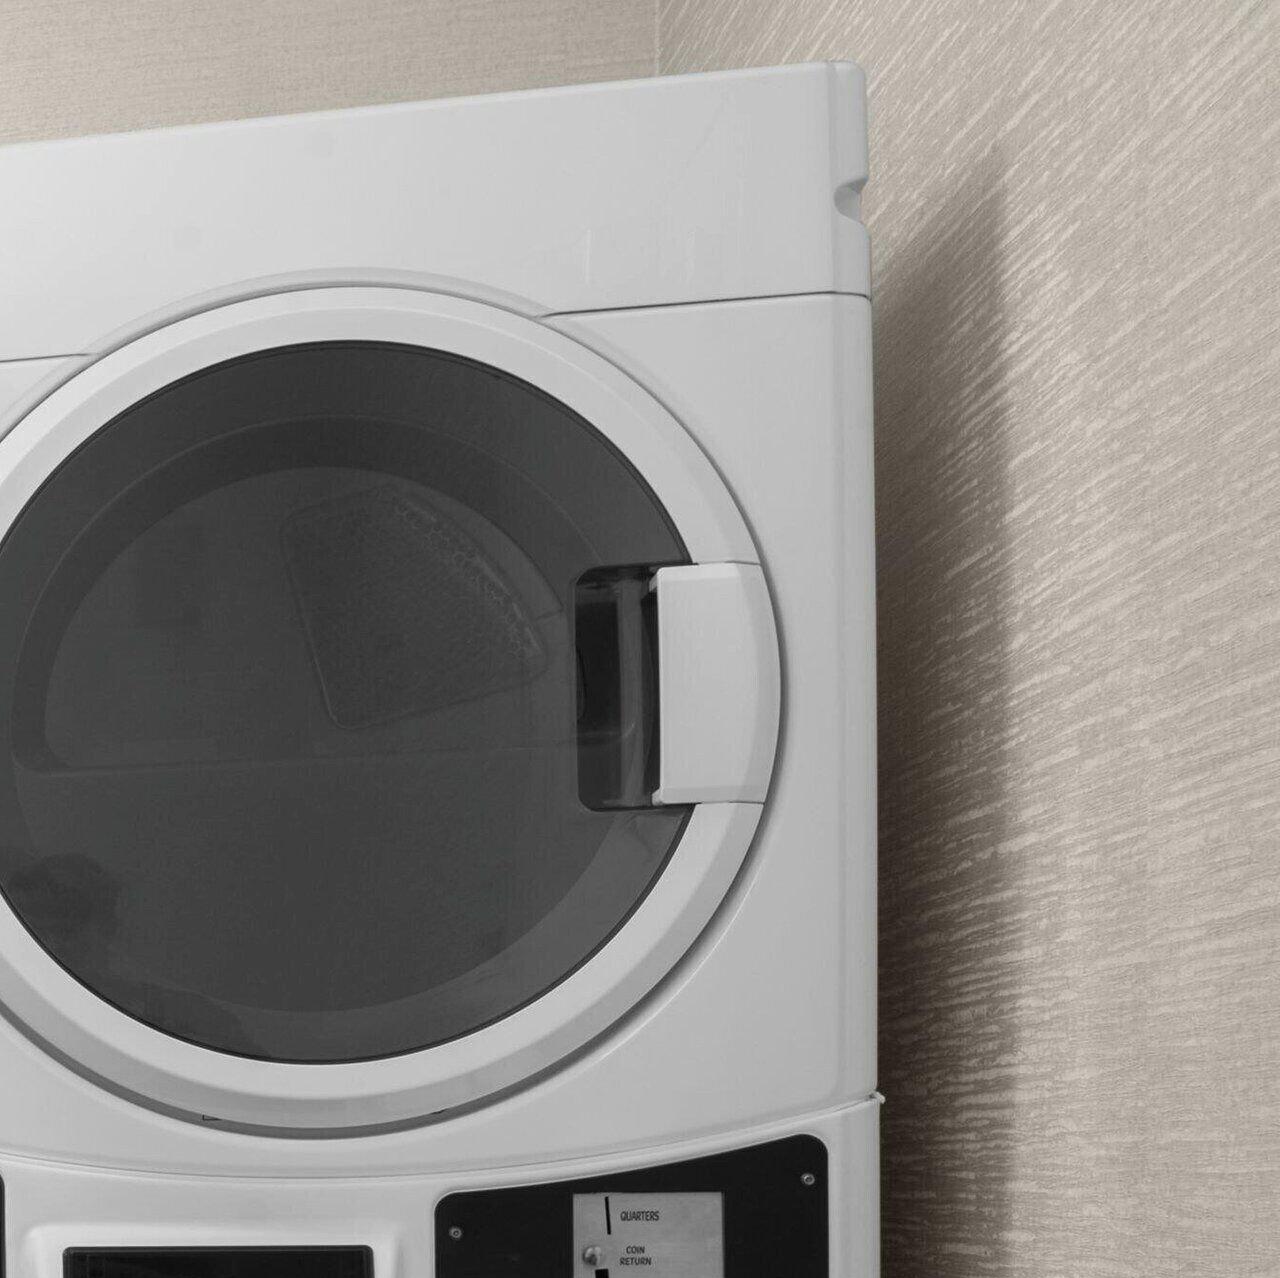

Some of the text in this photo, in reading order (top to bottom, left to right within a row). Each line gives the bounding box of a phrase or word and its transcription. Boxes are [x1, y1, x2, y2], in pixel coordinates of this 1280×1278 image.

[620, 1210, 660, 1222] QUARTERS
[626, 1246, 645, 1254] COIN
[620, 1257, 652, 1266] RETURN
